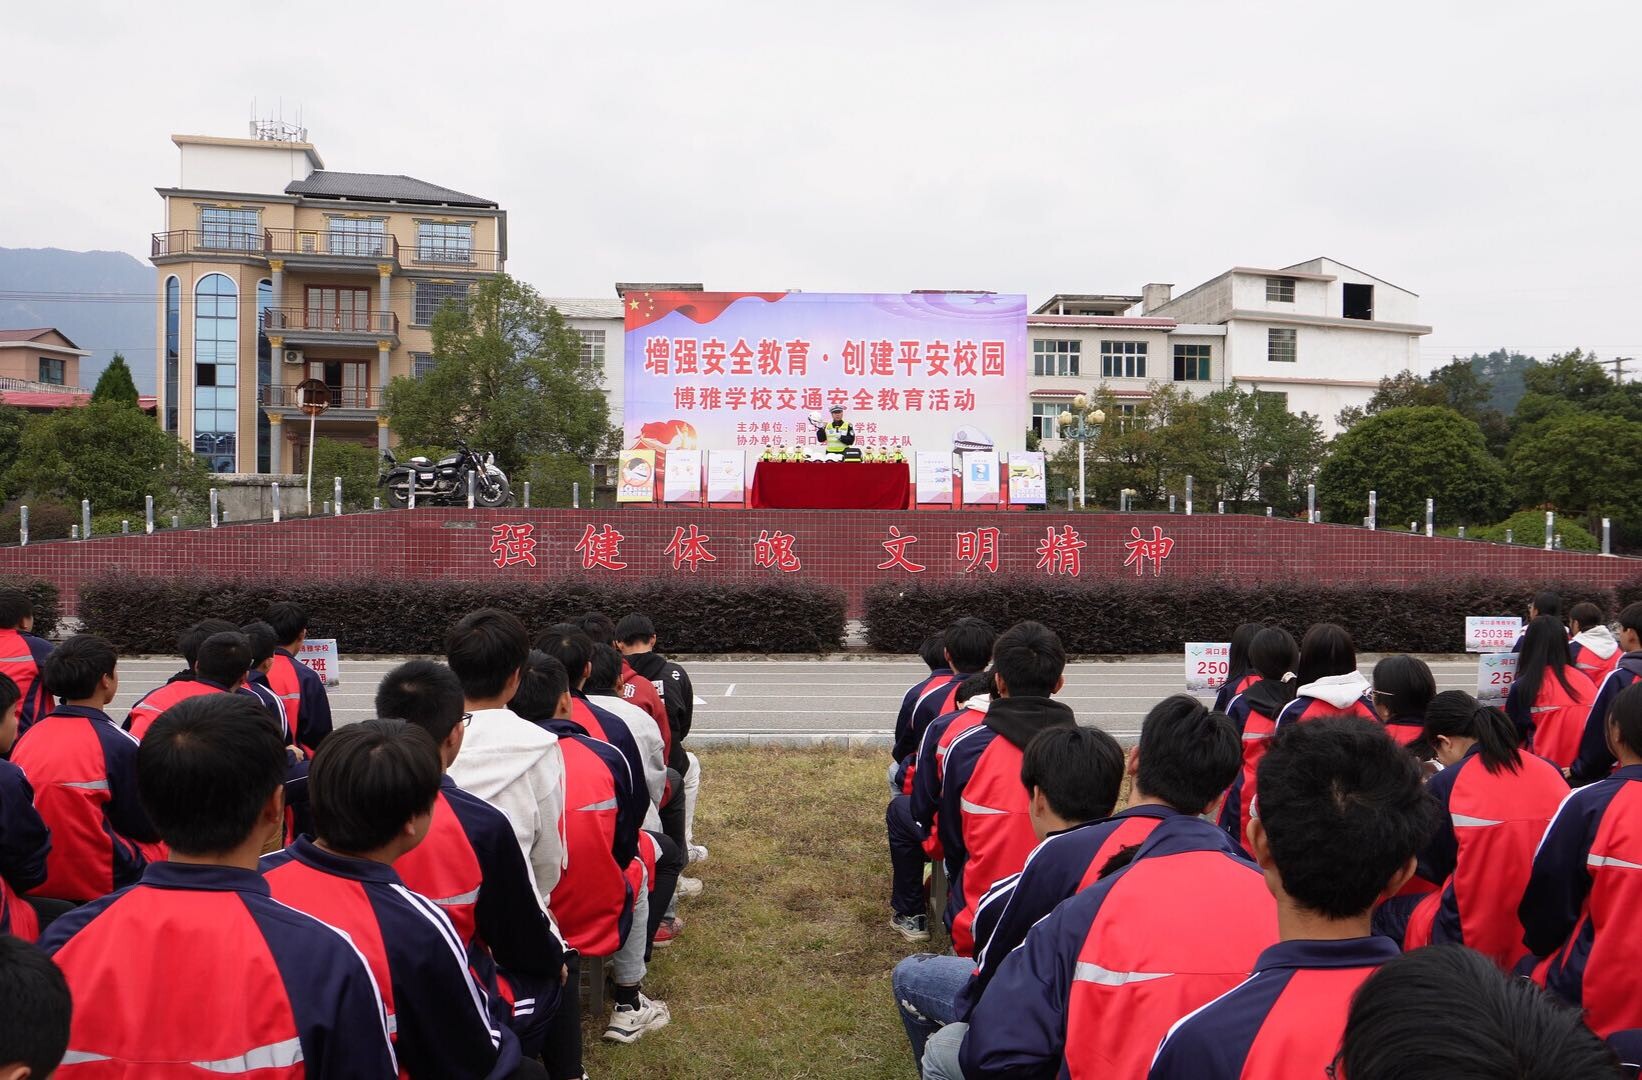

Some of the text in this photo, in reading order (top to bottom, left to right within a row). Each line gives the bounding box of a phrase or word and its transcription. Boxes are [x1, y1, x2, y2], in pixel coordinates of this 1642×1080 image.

[674, 387, 976, 411] 博雅学校交通安全教育活动
[737, 435, 912, 446] 协办单位：洞口局交警大队
[489, 523, 1175, 577] 强健体魄 文明精神
[1474, 629, 1513, 638] 2503班
[1197, 662, 1228, 674] 250
[1490, 672, 1516, 684] 25
